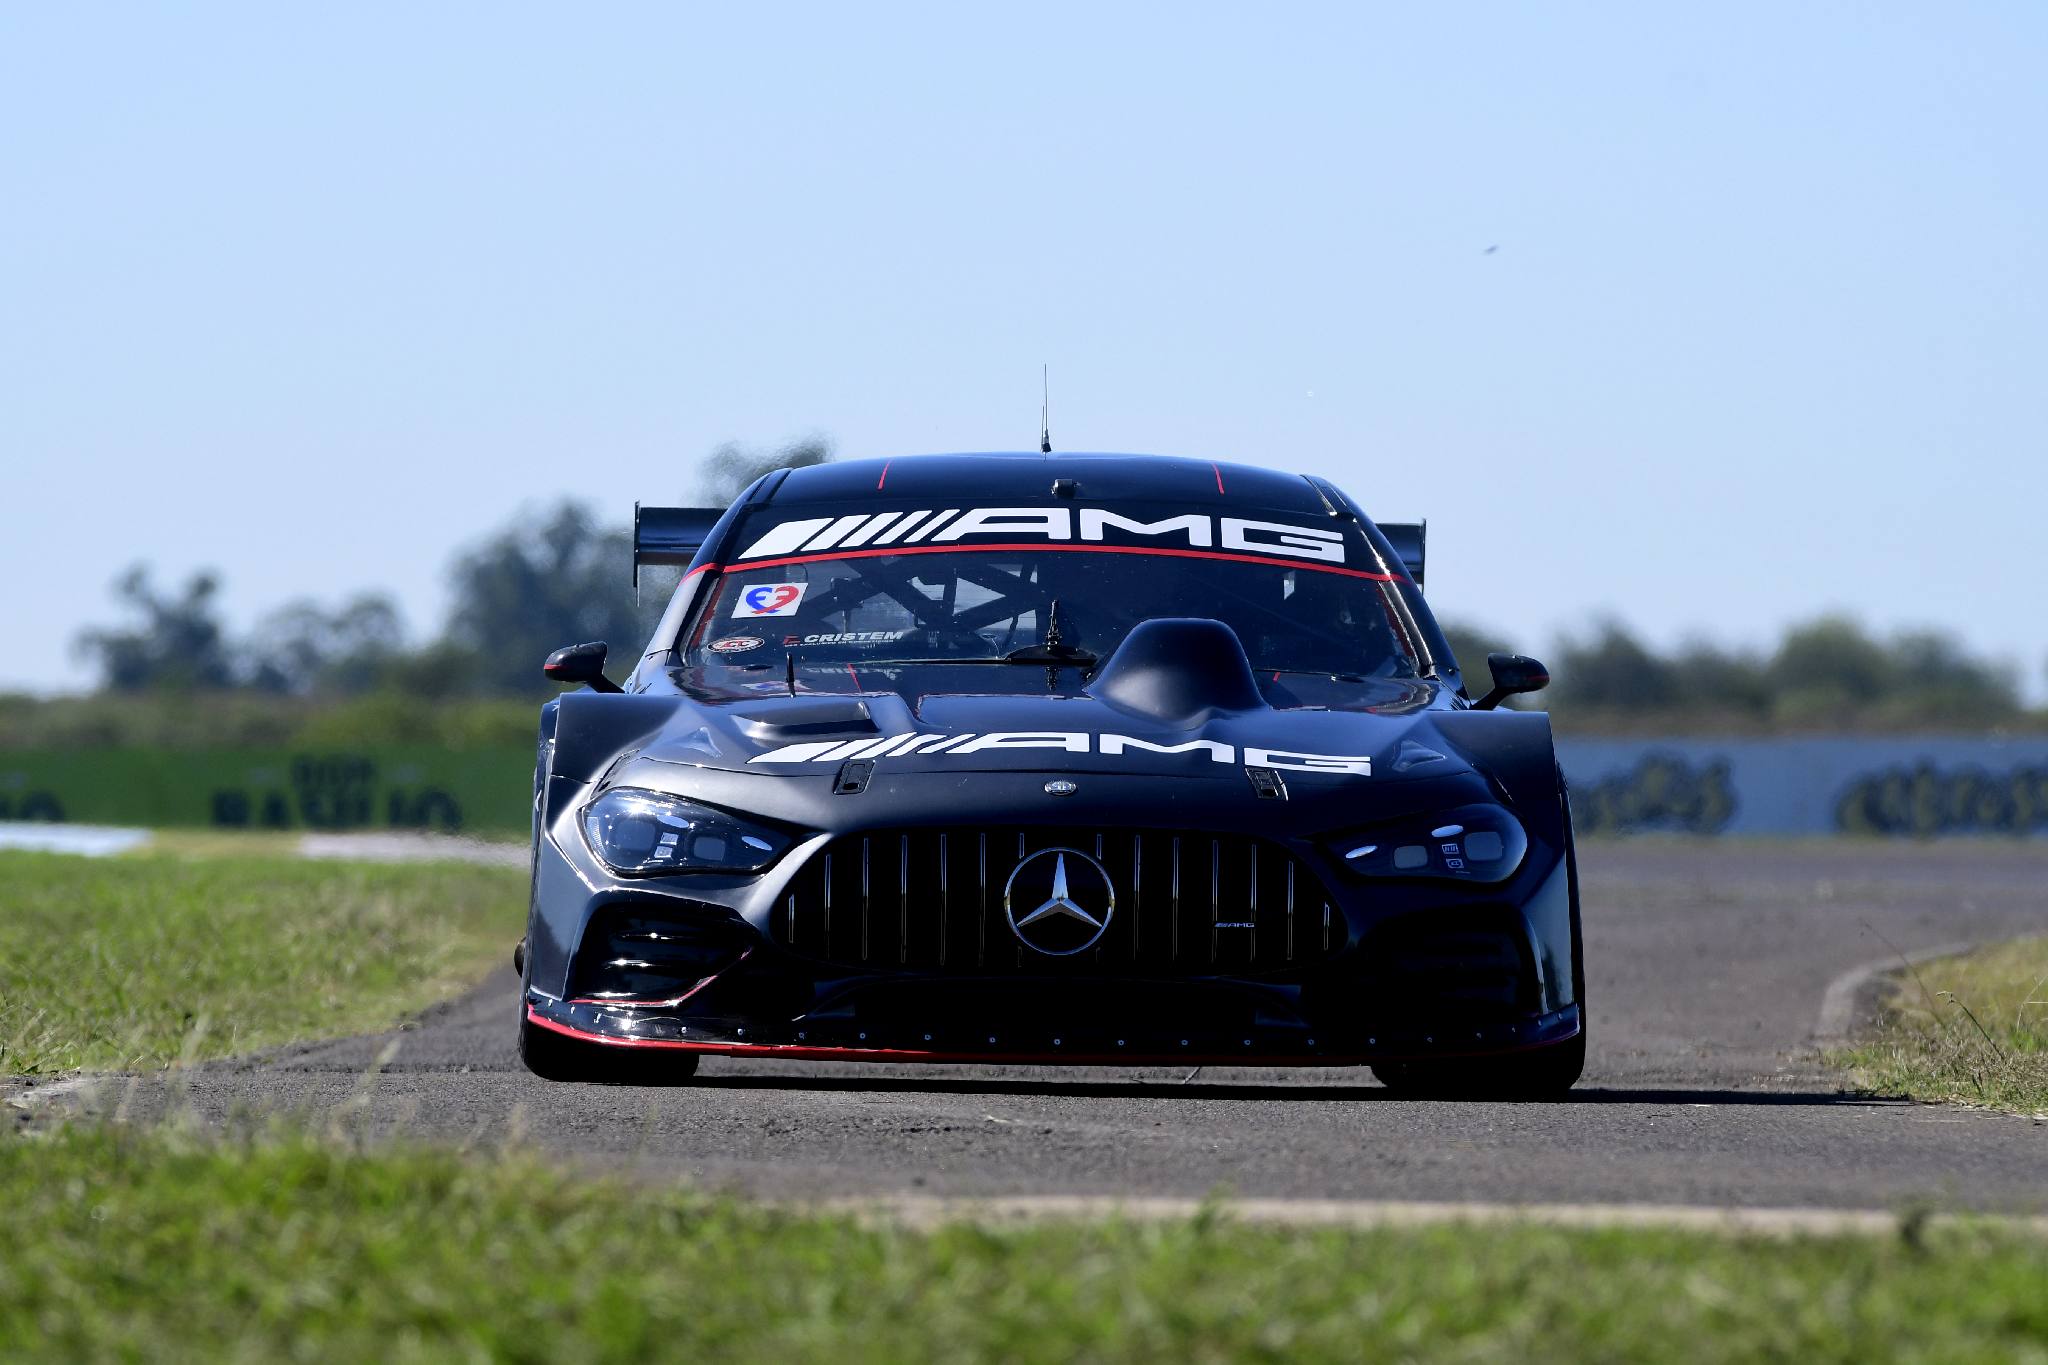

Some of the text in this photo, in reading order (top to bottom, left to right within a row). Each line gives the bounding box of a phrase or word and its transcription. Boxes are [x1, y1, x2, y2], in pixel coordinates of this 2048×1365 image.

[931, 507, 1345, 564] AMG
[804, 631, 904, 643] CRISTEM
[945, 731, 1371, 777] AMG
